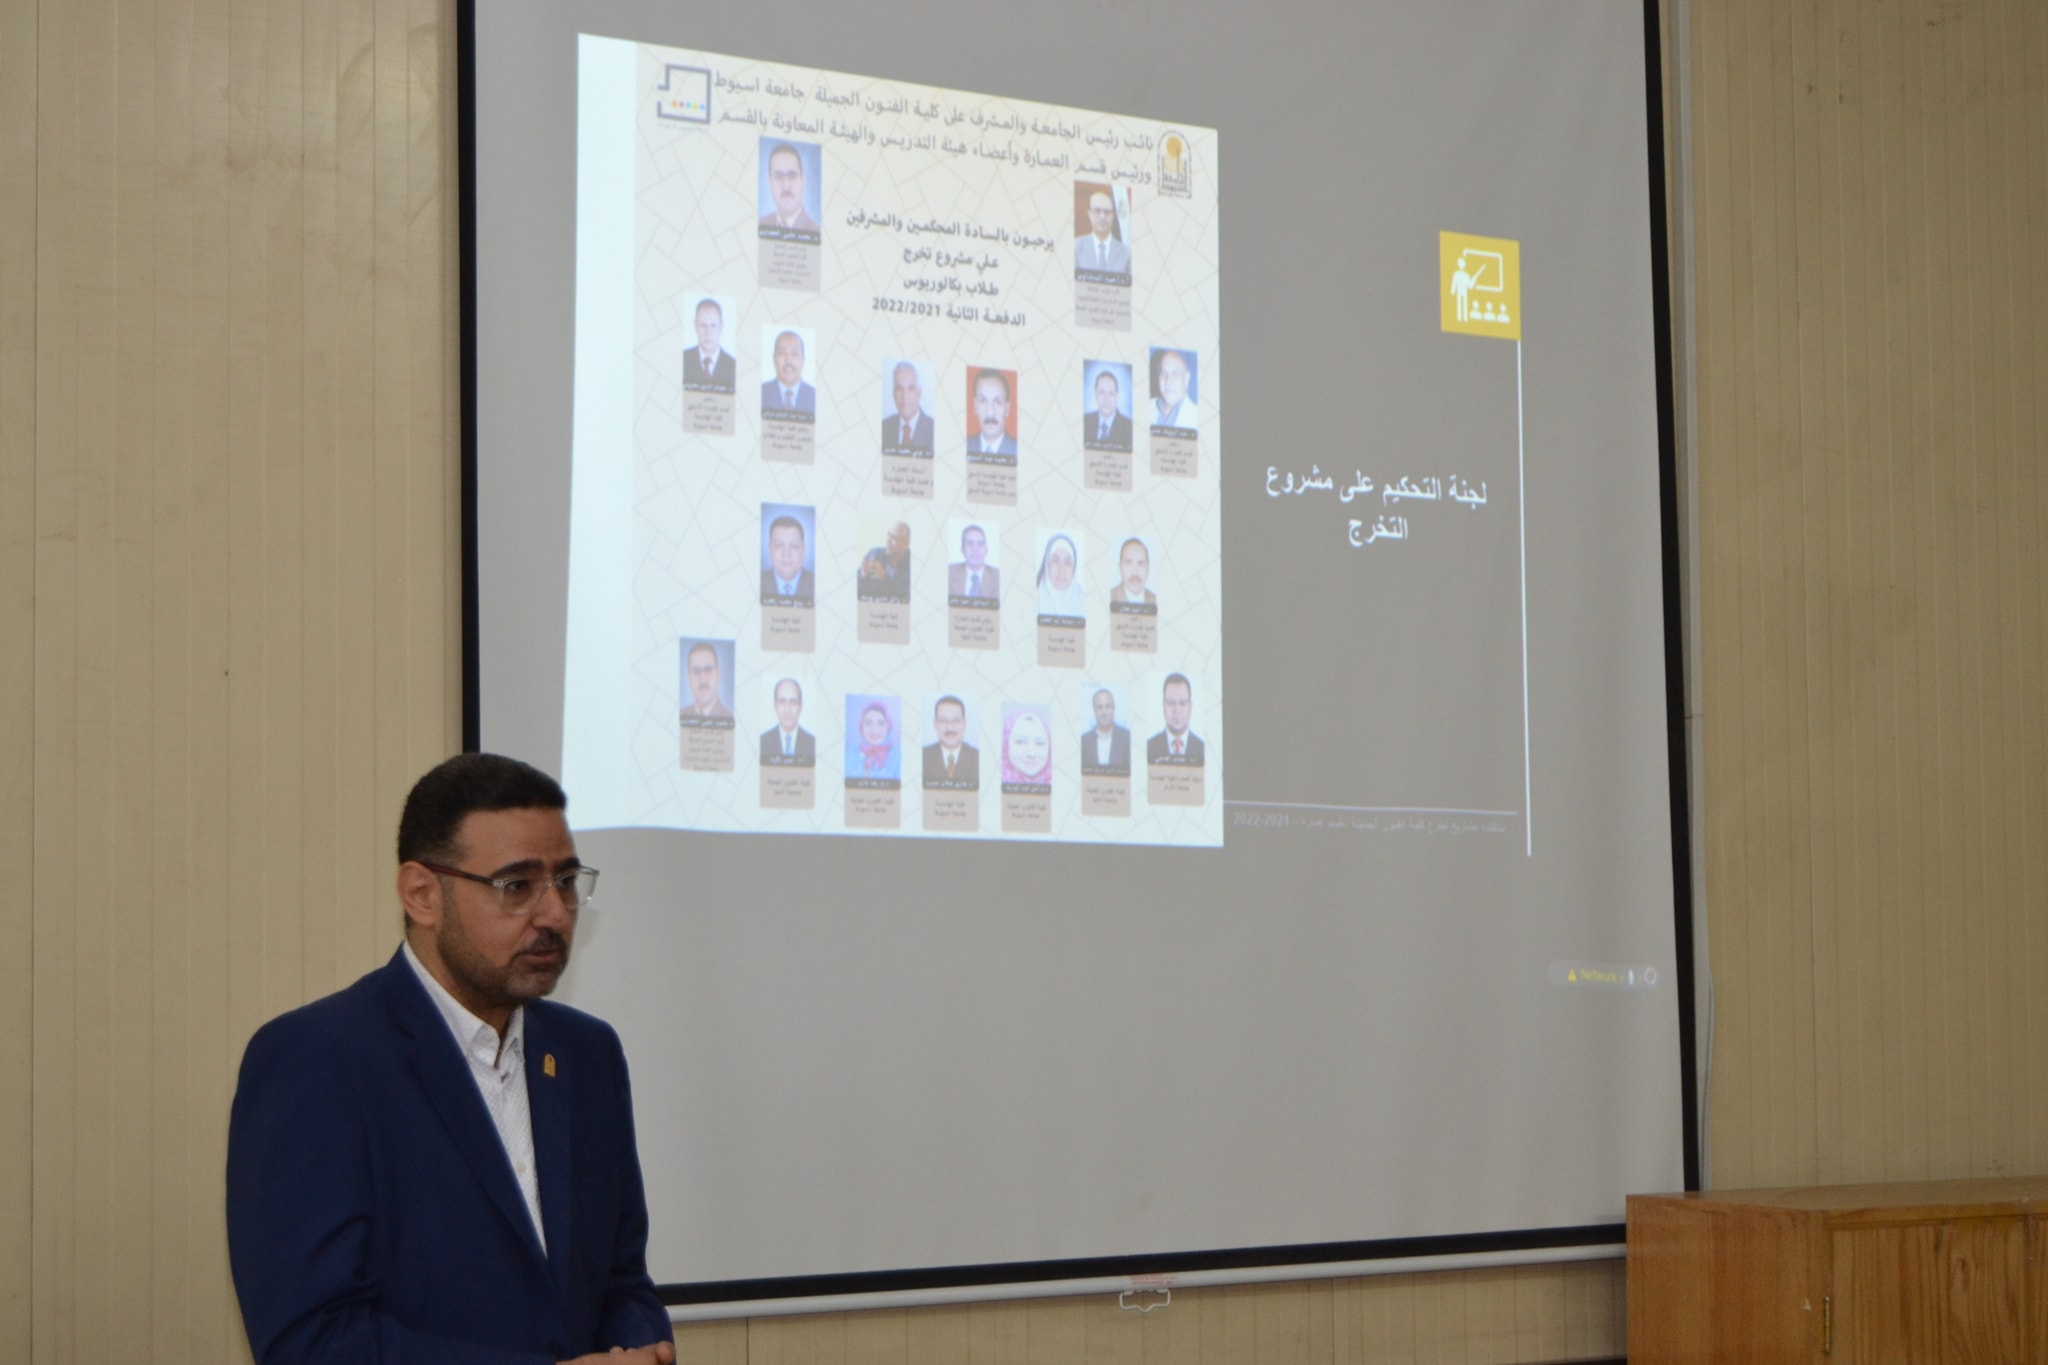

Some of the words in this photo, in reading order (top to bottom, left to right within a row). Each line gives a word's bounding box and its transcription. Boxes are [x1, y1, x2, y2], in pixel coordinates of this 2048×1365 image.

[714, 70, 760, 95] اسيوط
[765, 79, 805, 104] جامعة
[815, 85, 860, 110] الجميلة
[865, 95, 909, 116] الفنون
[718, 107, 768, 132] بالقسم
[772, 111, 825, 135] المعاونة
[914, 102, 940, 122] كلية
[970, 110, 1026, 136] والمشرف
[829, 121, 876, 146] والهيئة
[1031, 118, 1081, 139] الجامعة
[1086, 129, 1119, 148] رئيس
[880, 133, 937, 152] التدريس
[941, 136, 968, 155] هيئة
[972, 140, 1020, 165] وأعضاء
[1123, 133, 1154, 151] نائب
[1024, 147, 1070, 168] العمارة
[1075, 157, 1106, 174] قسم
[1112, 163, 1152, 184] ورئيس
[846, 207, 903, 232] والمشرفين
[906, 217, 961, 237] المحكمين
[964, 223, 1009, 247] بالسادة
[1012, 230, 1055, 253] يرحبون
[903, 245, 932, 264] تخرج
[935, 250, 973, 268] مشروع
[903, 275, 962, 297] بكالوريوس
[965, 281, 1000, 298] طلاب
[872, 296, 941, 318] 2022/2021
[983, 306, 1026, 327] الدفعة
[1265, 464, 1334, 497] مشروع
[1339, 468, 1375, 503] على
[1382, 473, 1442, 507] التحكيم
[1447, 473, 1488, 511] لجنة
[1347, 514, 1409, 549] التخرج
